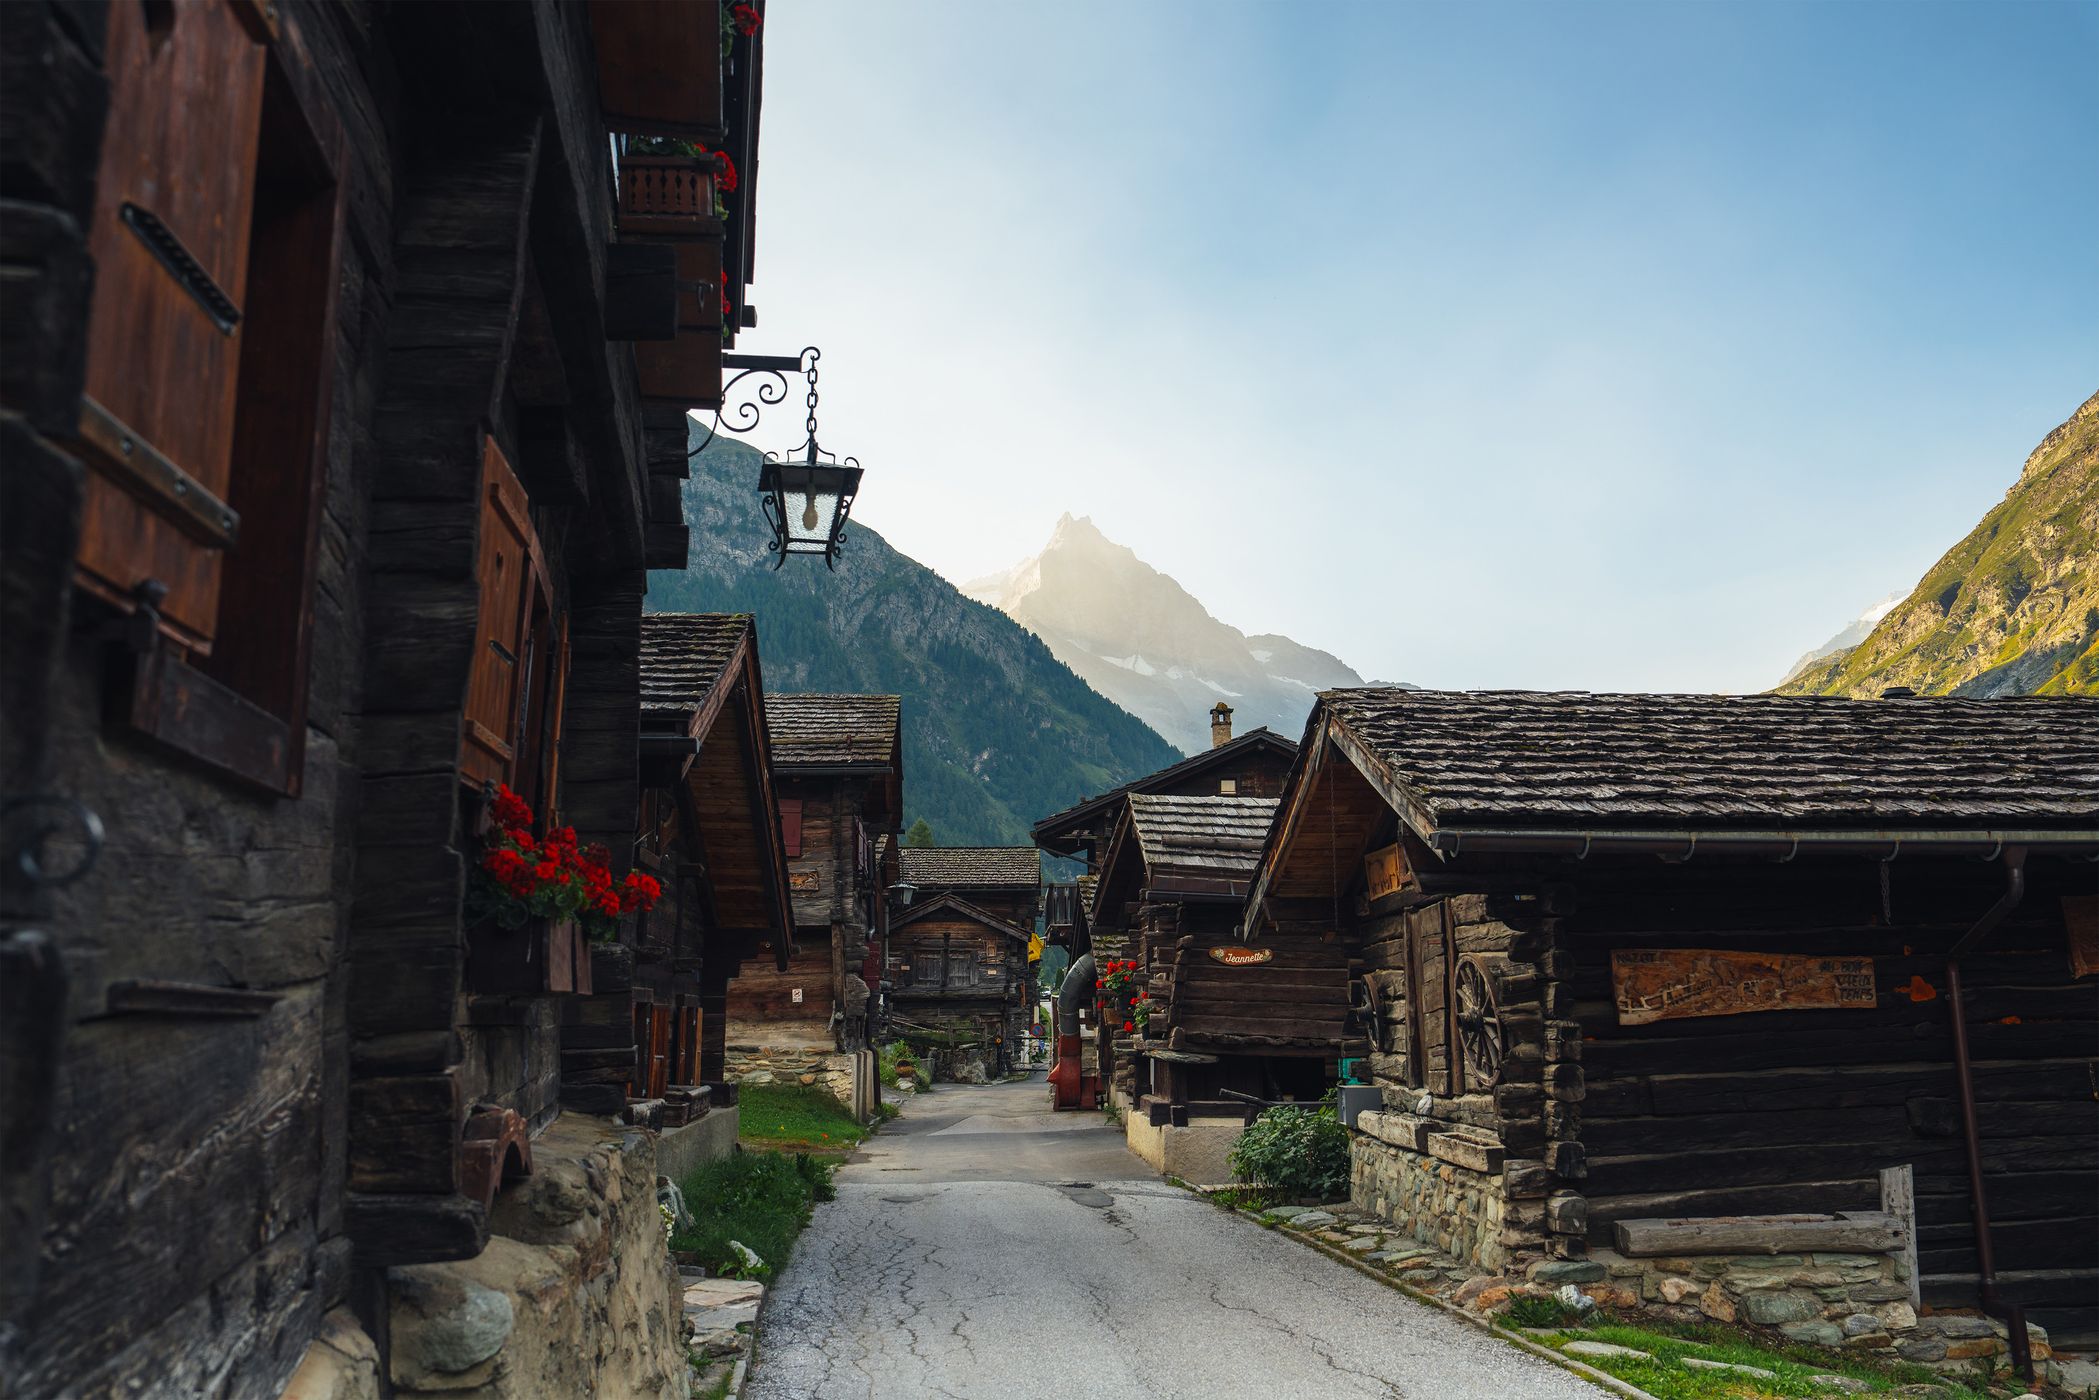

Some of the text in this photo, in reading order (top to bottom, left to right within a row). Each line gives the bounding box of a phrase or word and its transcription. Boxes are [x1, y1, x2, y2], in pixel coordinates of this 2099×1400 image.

[1225, 952, 1264, 963] Jeannette
[1833, 974, 1872, 987] VIEUX
[1839, 988, 1874, 1001] TEMPS
